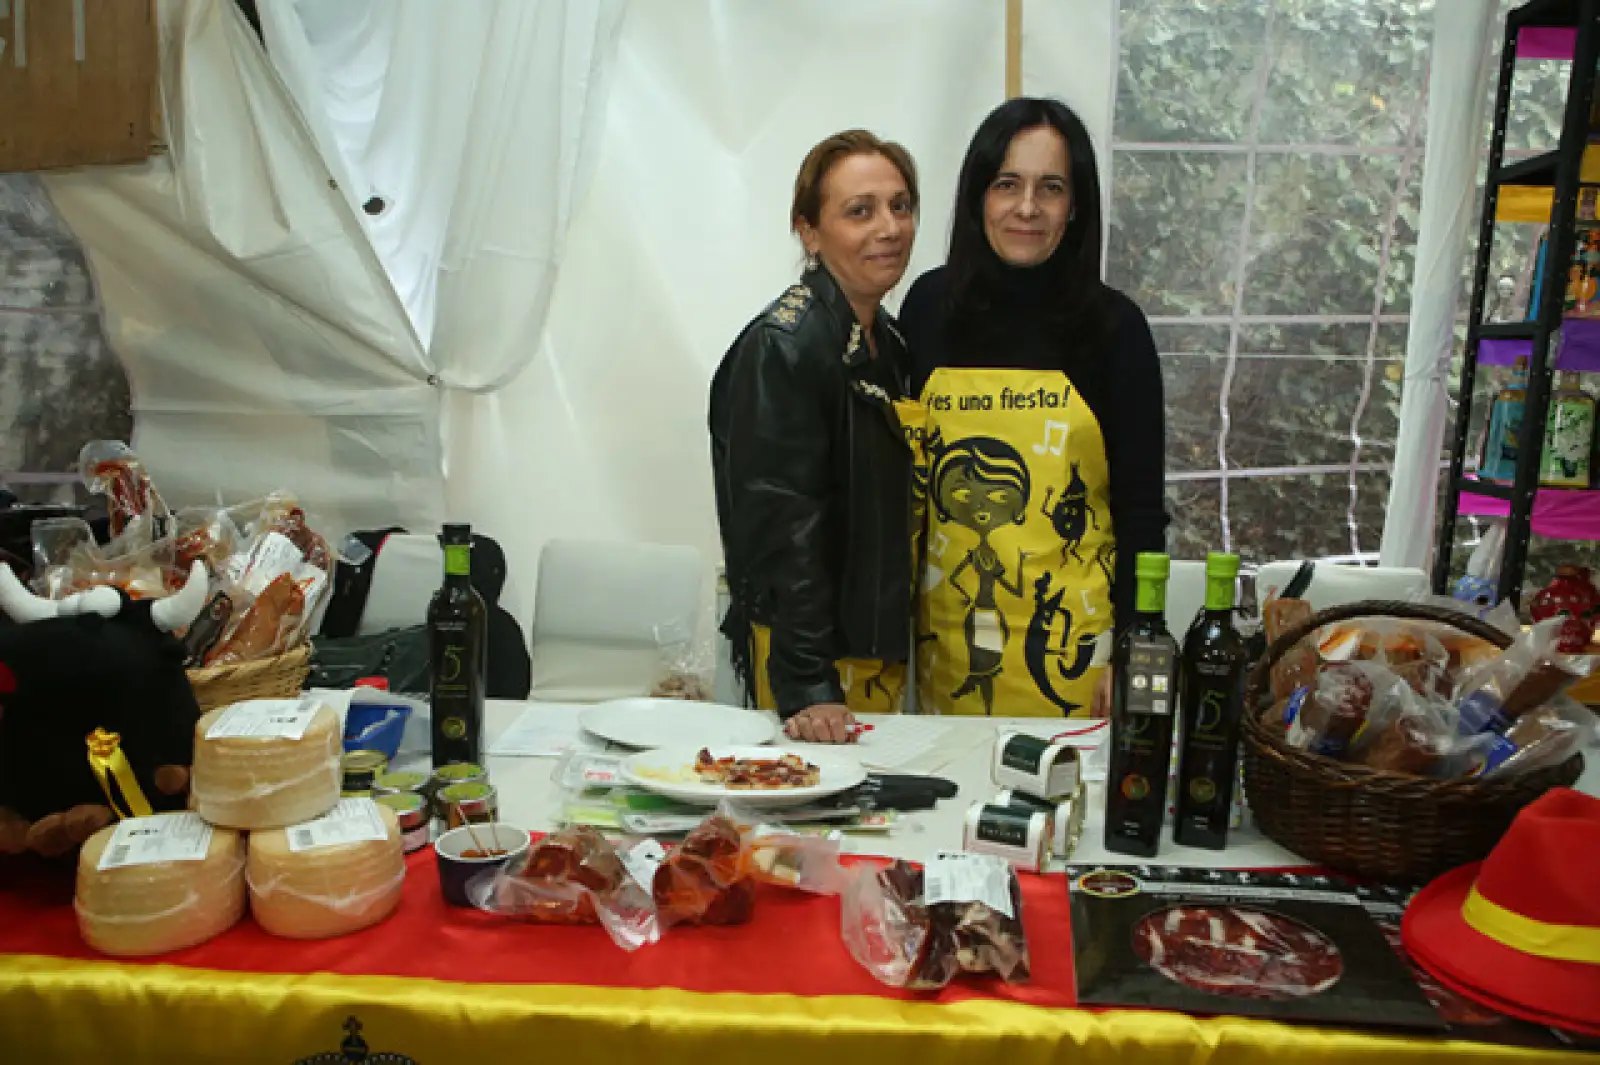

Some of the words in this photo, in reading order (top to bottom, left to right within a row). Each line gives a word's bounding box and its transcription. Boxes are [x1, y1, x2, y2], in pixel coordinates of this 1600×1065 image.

[959, 394, 993, 411] una
[1000, 384, 1071, 411] fiesta!
[439, 644, 465, 681] 5
